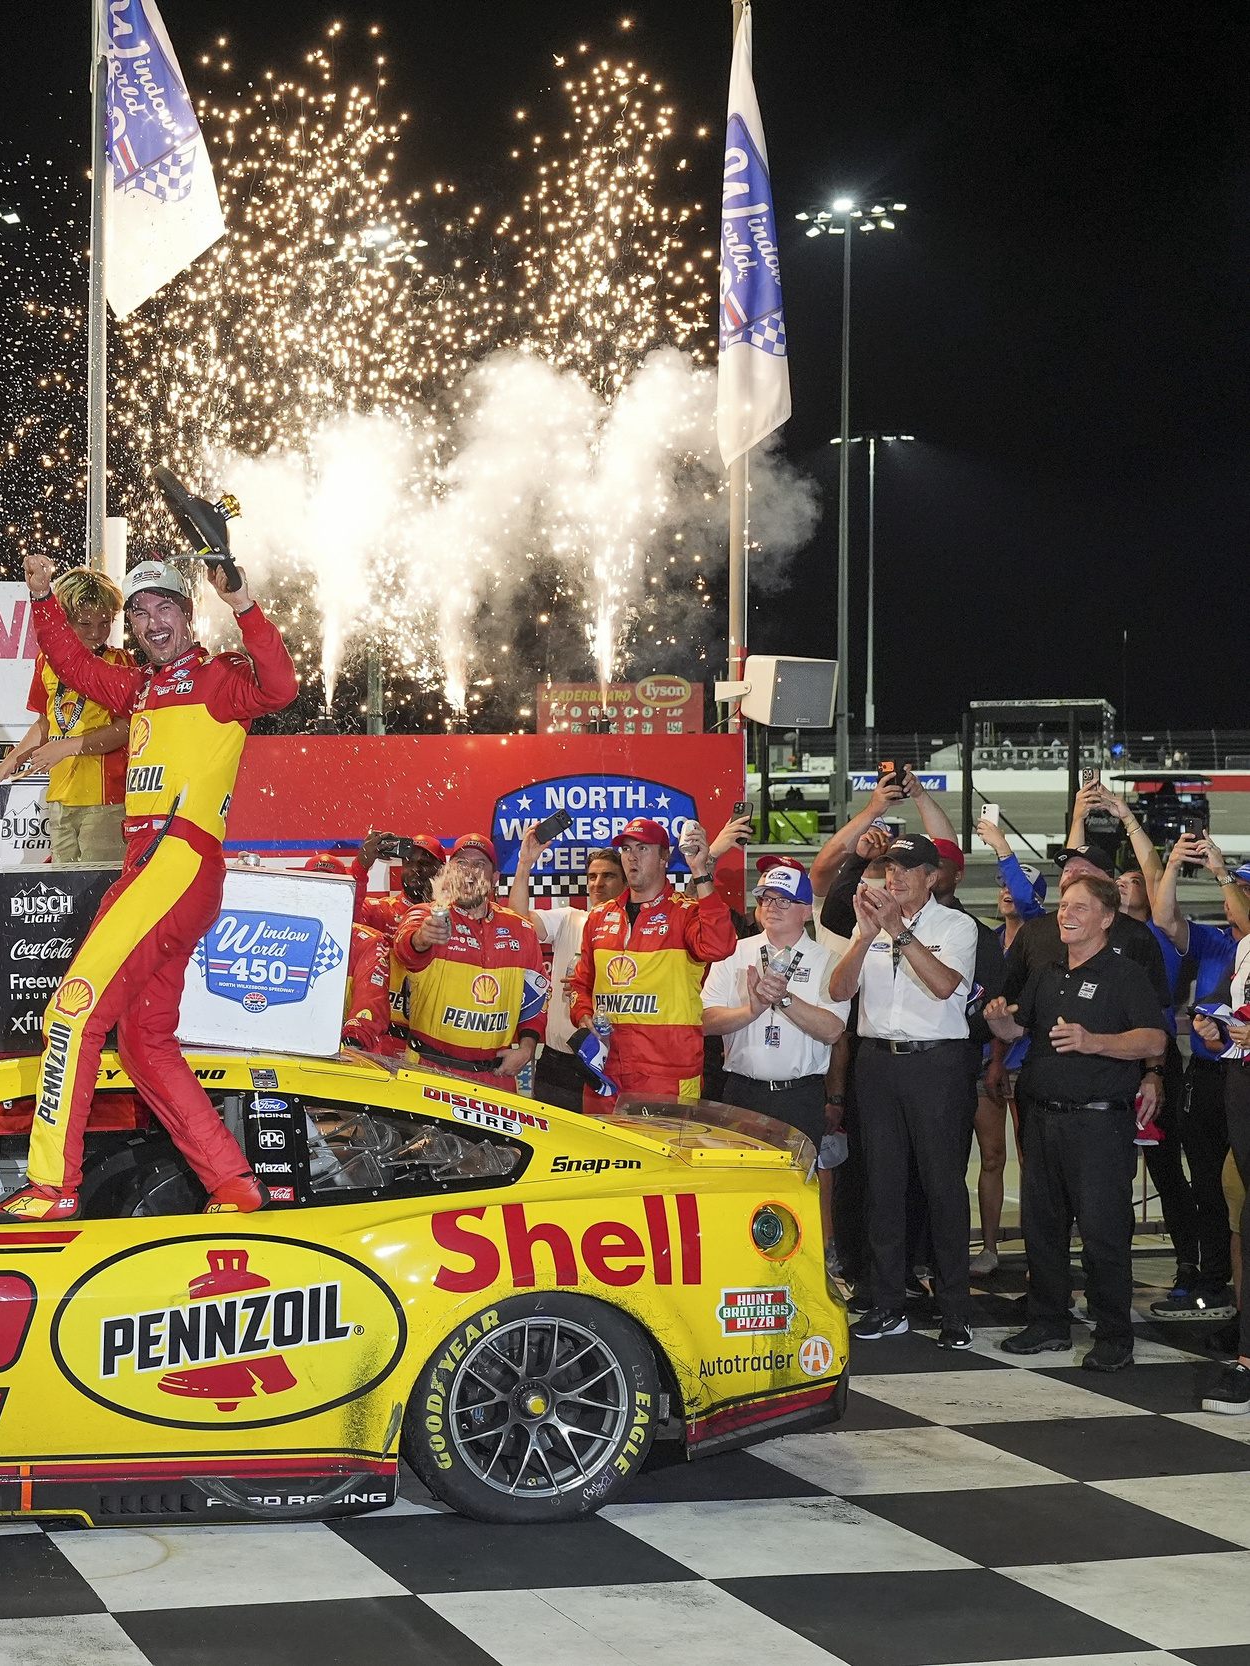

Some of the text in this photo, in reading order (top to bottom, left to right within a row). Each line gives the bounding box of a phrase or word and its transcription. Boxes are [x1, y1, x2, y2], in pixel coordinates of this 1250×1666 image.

[644, 685, 686, 700] Tyson
[667, 708, 683, 717] LAP
[127, 767, 164, 793] ZOIL
[545, 786, 646, 810] NORTH
[1, 817, 51, 839] BUSC
[499, 817, 691, 841] WKESBRO
[11, 896, 74, 916] BUSCH
[24, 915, 59, 923] LIGHT
[215, 916, 310, 954] Window
[10, 973, 62, 989] Freew
[229, 957, 287, 984] 450
[443, 1006, 510, 1032] PENNZOIL
[257, 1101, 282, 1110] Ford
[423, 1086, 550, 1132] DISCOUNT
[459, 1108, 515, 1132] TIRE
[260, 1132, 283, 1147] PPG
[255, 1162, 292, 1174] Mazak
[550, 1156, 641, 1174] Snap-on
[59, 1198, 75, 1208] 22
[432, 1194, 702, 1294] Shell
[737, 1293, 774, 1306] HUNT
[722, 1304, 789, 1318] BROTHERS
[101, 1284, 350, 1378] PENNZOIL
[737, 1316, 775, 1329] PIZZA
[699, 1350, 794, 1378] Autotrader
[426, 1311, 501, 1470] GOODYEAR
[614, 1392, 651, 1476] EAGLE
[206, 1492, 387, 1507] FRD RAING
